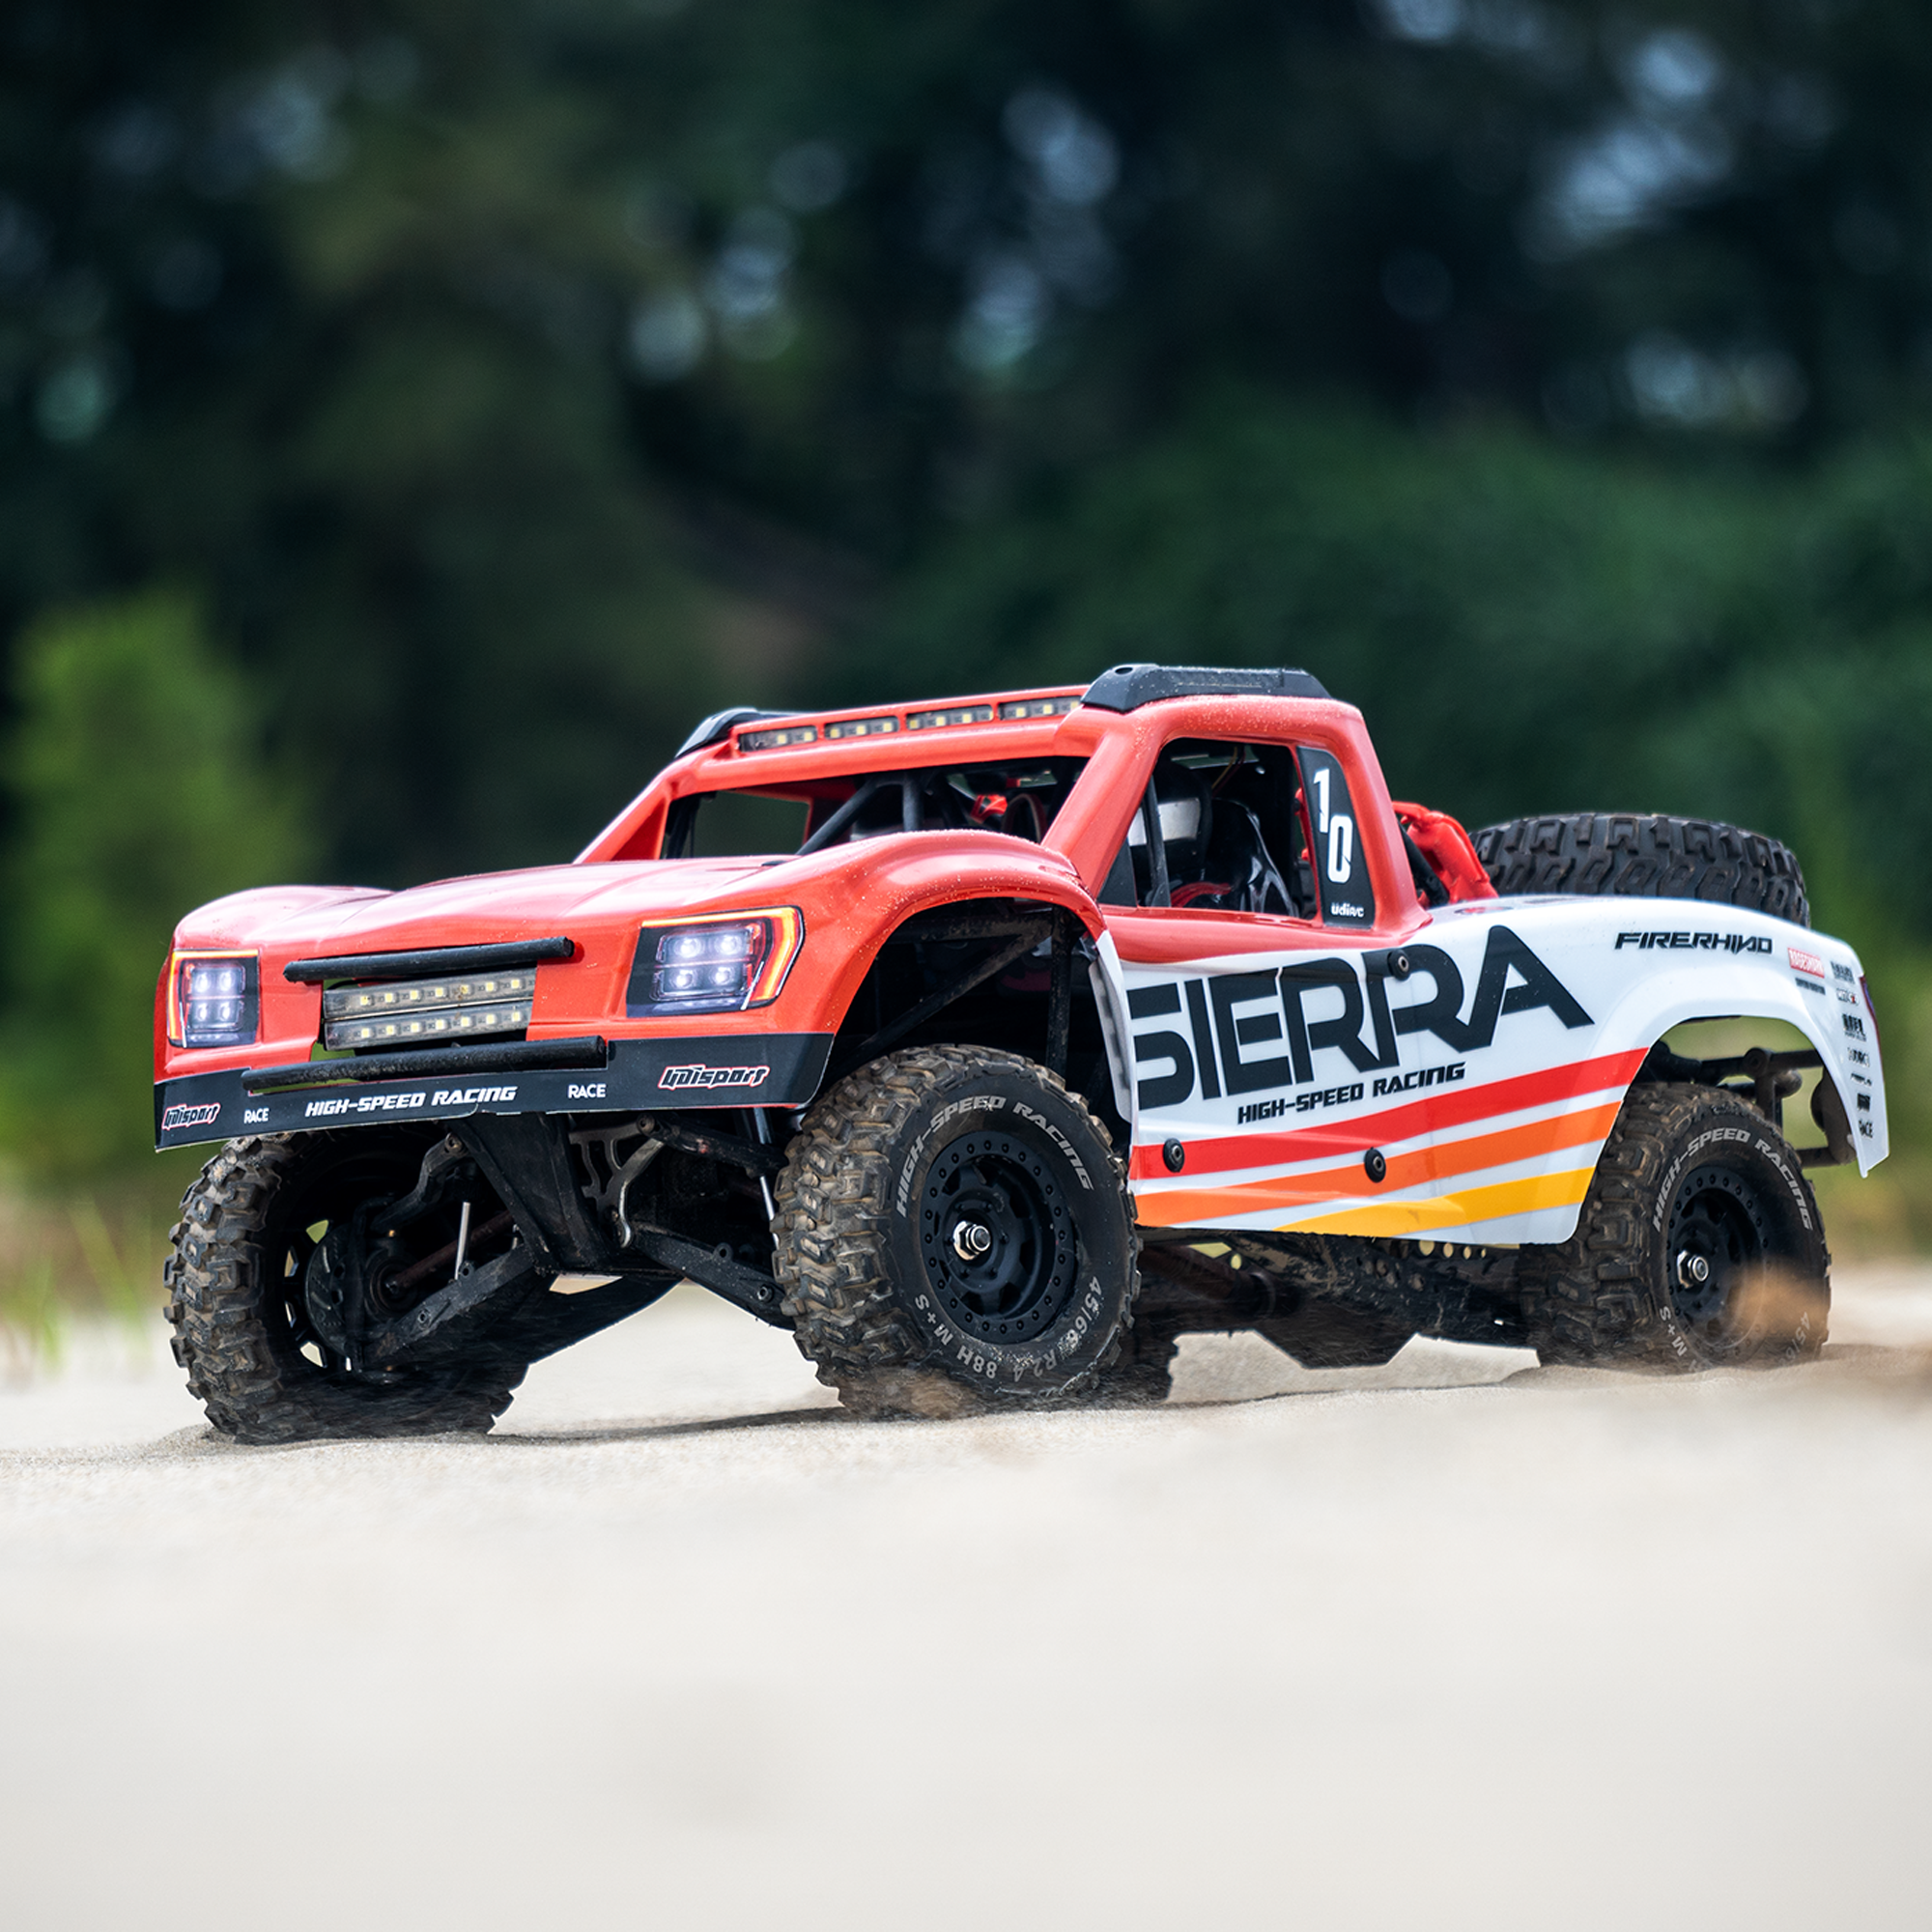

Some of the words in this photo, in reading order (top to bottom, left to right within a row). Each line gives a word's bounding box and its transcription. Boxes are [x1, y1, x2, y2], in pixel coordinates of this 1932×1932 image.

[1614, 931, 1774, 955] FIRERHINO
[1125, 923, 1596, 1112] SIERRA
[304, 1091, 427, 1118] HIGH-SPEED
[431, 1085, 519, 1108] RACING
[567, 1082, 608, 1099] RACE
[1236, 1082, 1364, 1125] HIGH-SPEED
[1372, 1062, 1466, 1098] RACING
[243, 1107, 270, 1124] RACE
[896, 1094, 1008, 1219] HIGH-SPEED
[1012, 1100, 1094, 1191] RACING
[1651, 1127, 1751, 1233] HIGH-SPEED
[1754, 1138, 1814, 1232] RACING
[956, 1345, 998, 1379] 88H
